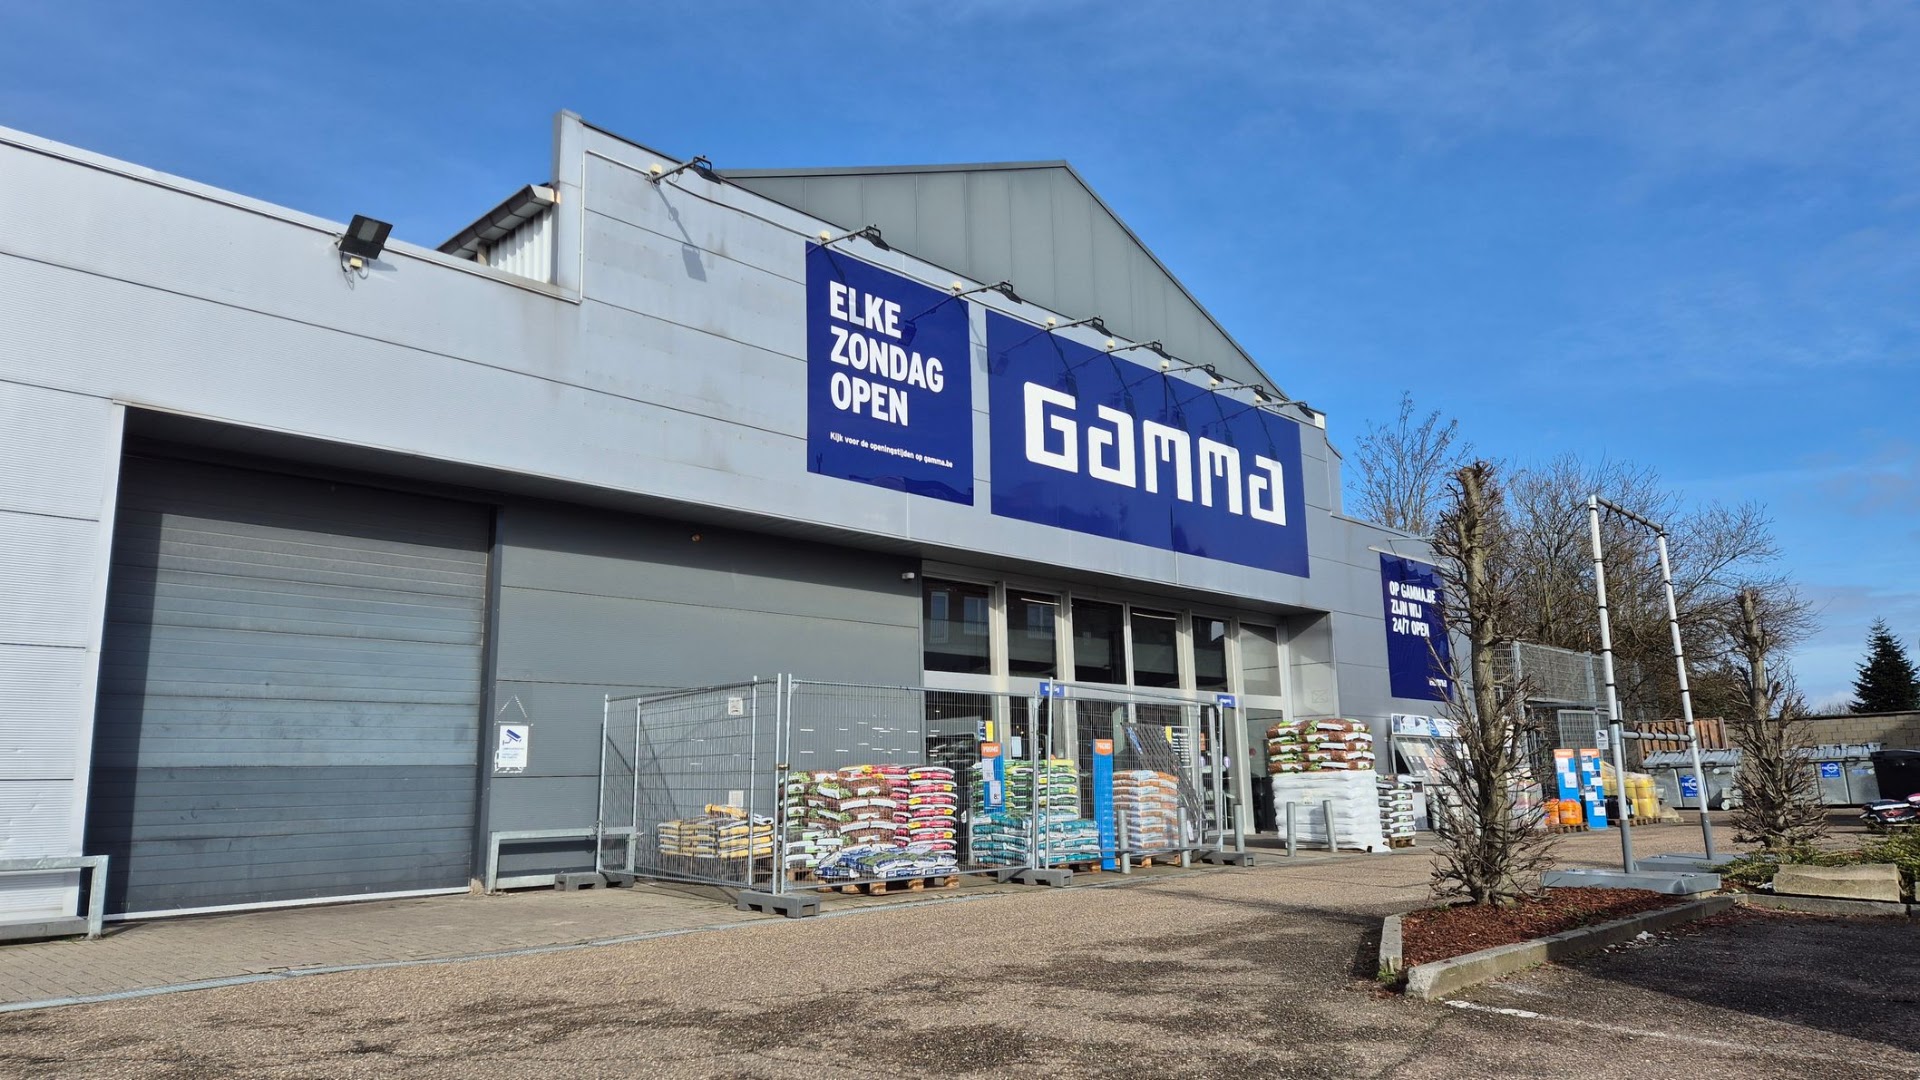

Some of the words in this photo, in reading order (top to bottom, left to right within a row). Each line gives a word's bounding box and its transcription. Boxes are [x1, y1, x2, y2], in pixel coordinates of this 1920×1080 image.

[830, 280, 902, 339] ELKE
[830, 325, 944, 393] ZONDAG
[830, 372, 909, 426] OPEN
[830, 432, 844, 443] Kijk
[844, 436, 860, 446] voor
[860, 439, 869, 448] de
[869, 442, 914, 459] openingstijden
[915, 452, 923, 463] op
[923, 455, 953, 468] gamma.be
[1389, 580, 1400, 596] OP
[1400, 585, 1436, 604] GAMMA.BE
[1390, 599, 1408, 616] ZIJN
[1408, 603, 1422, 619] WIJ
[1392, 617, 1410, 635] 24/7
[1410, 621, 1430, 638] OPEN
